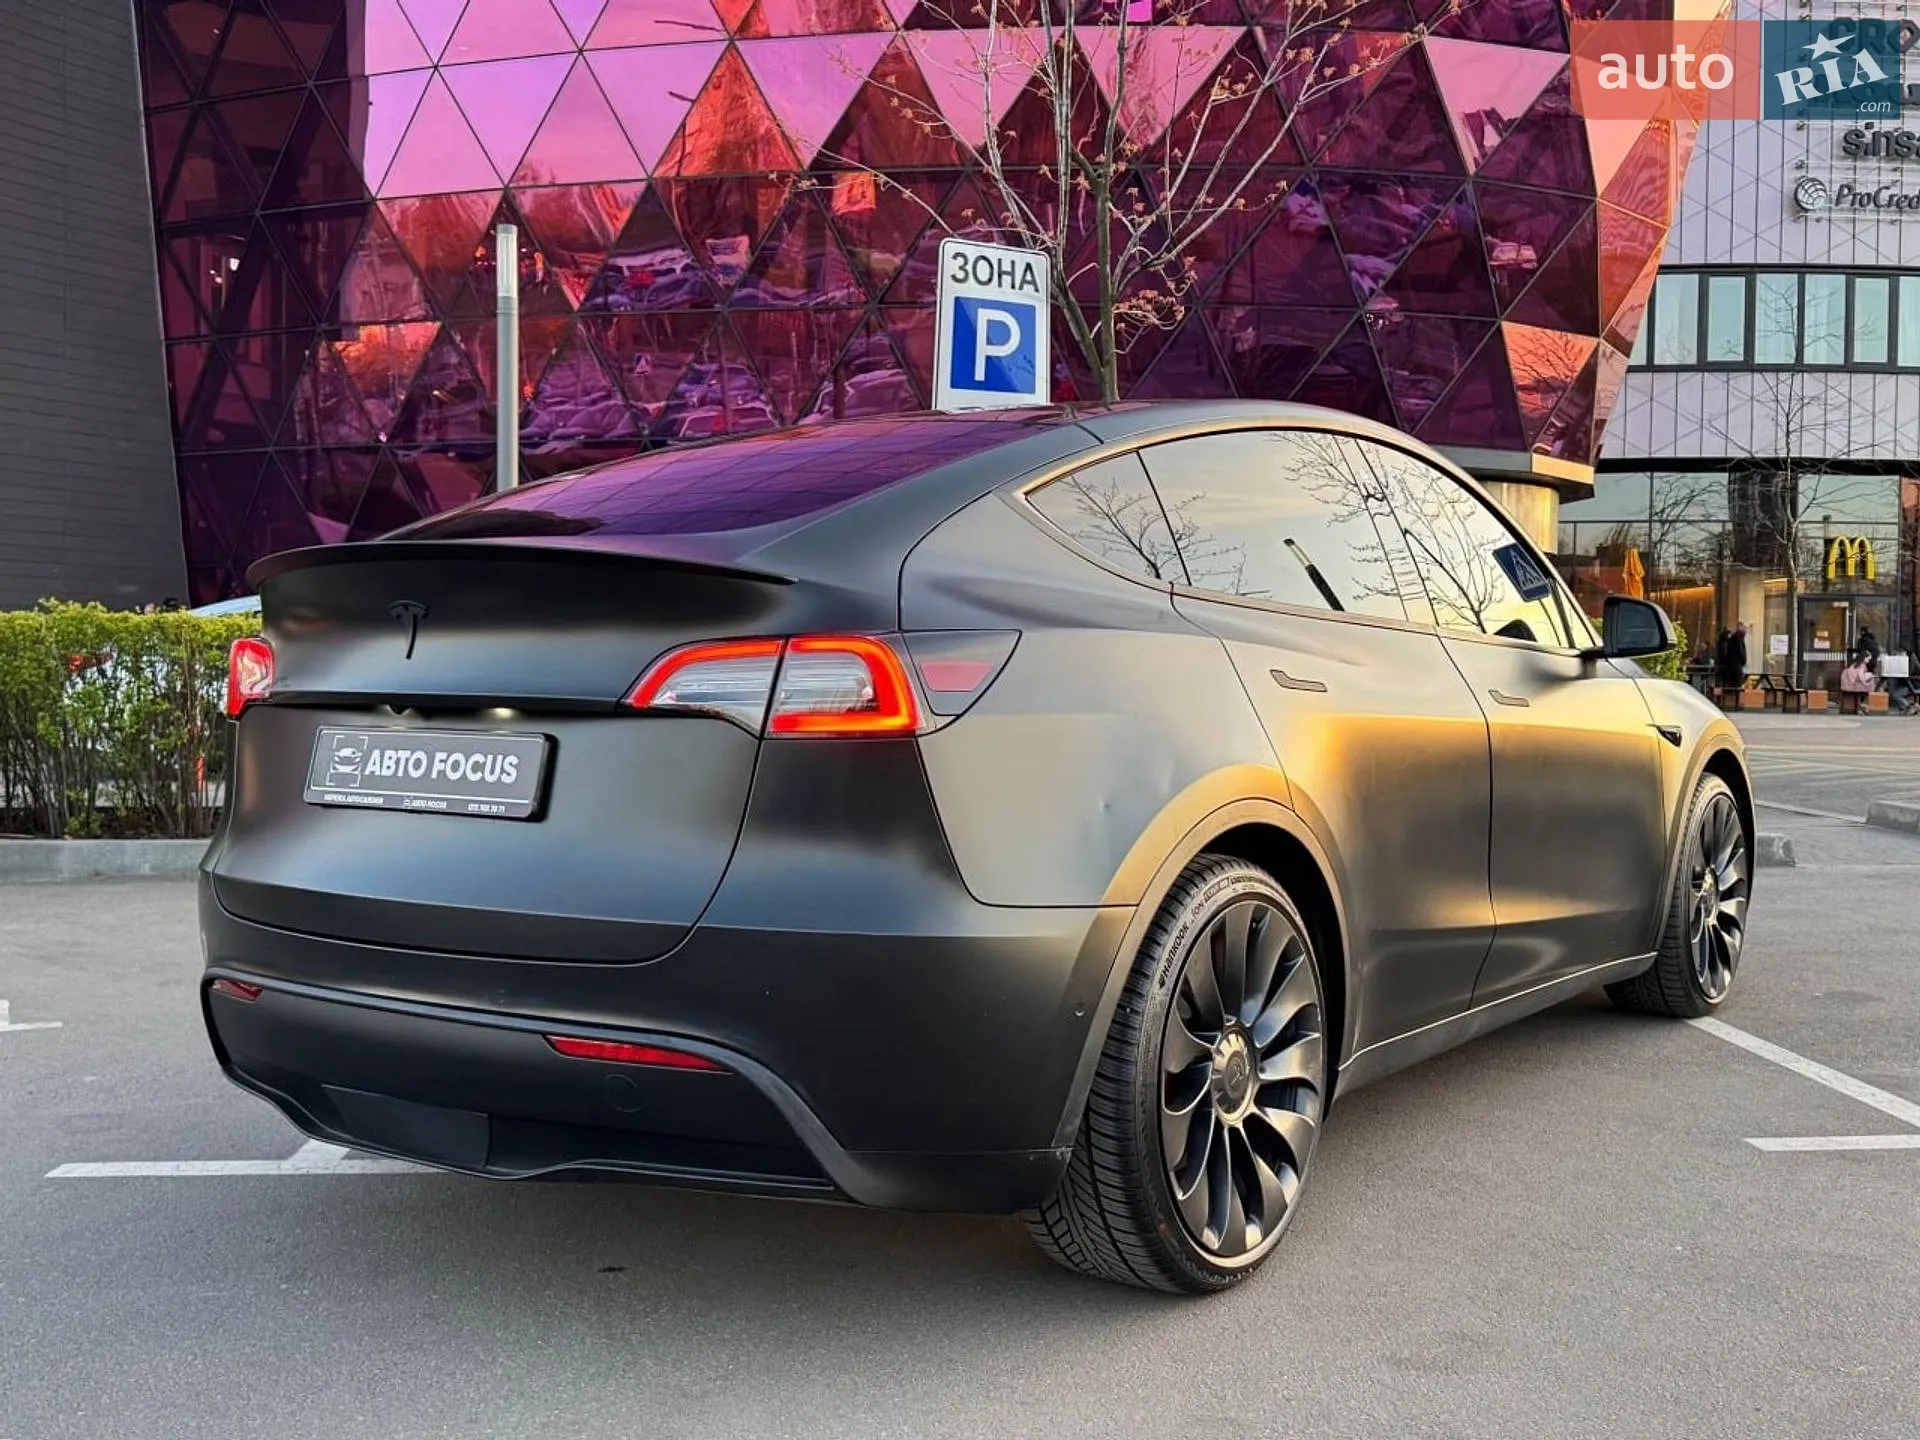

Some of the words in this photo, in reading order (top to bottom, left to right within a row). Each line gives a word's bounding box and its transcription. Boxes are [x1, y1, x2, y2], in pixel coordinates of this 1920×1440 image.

[1842, 121, 1920, 158] sins
[951, 252, 1040, 294] ЗОНА
[974, 307, 1021, 382] P
[364, 749, 428, 778] АВТО
[431, 752, 519, 784] FOCUS
